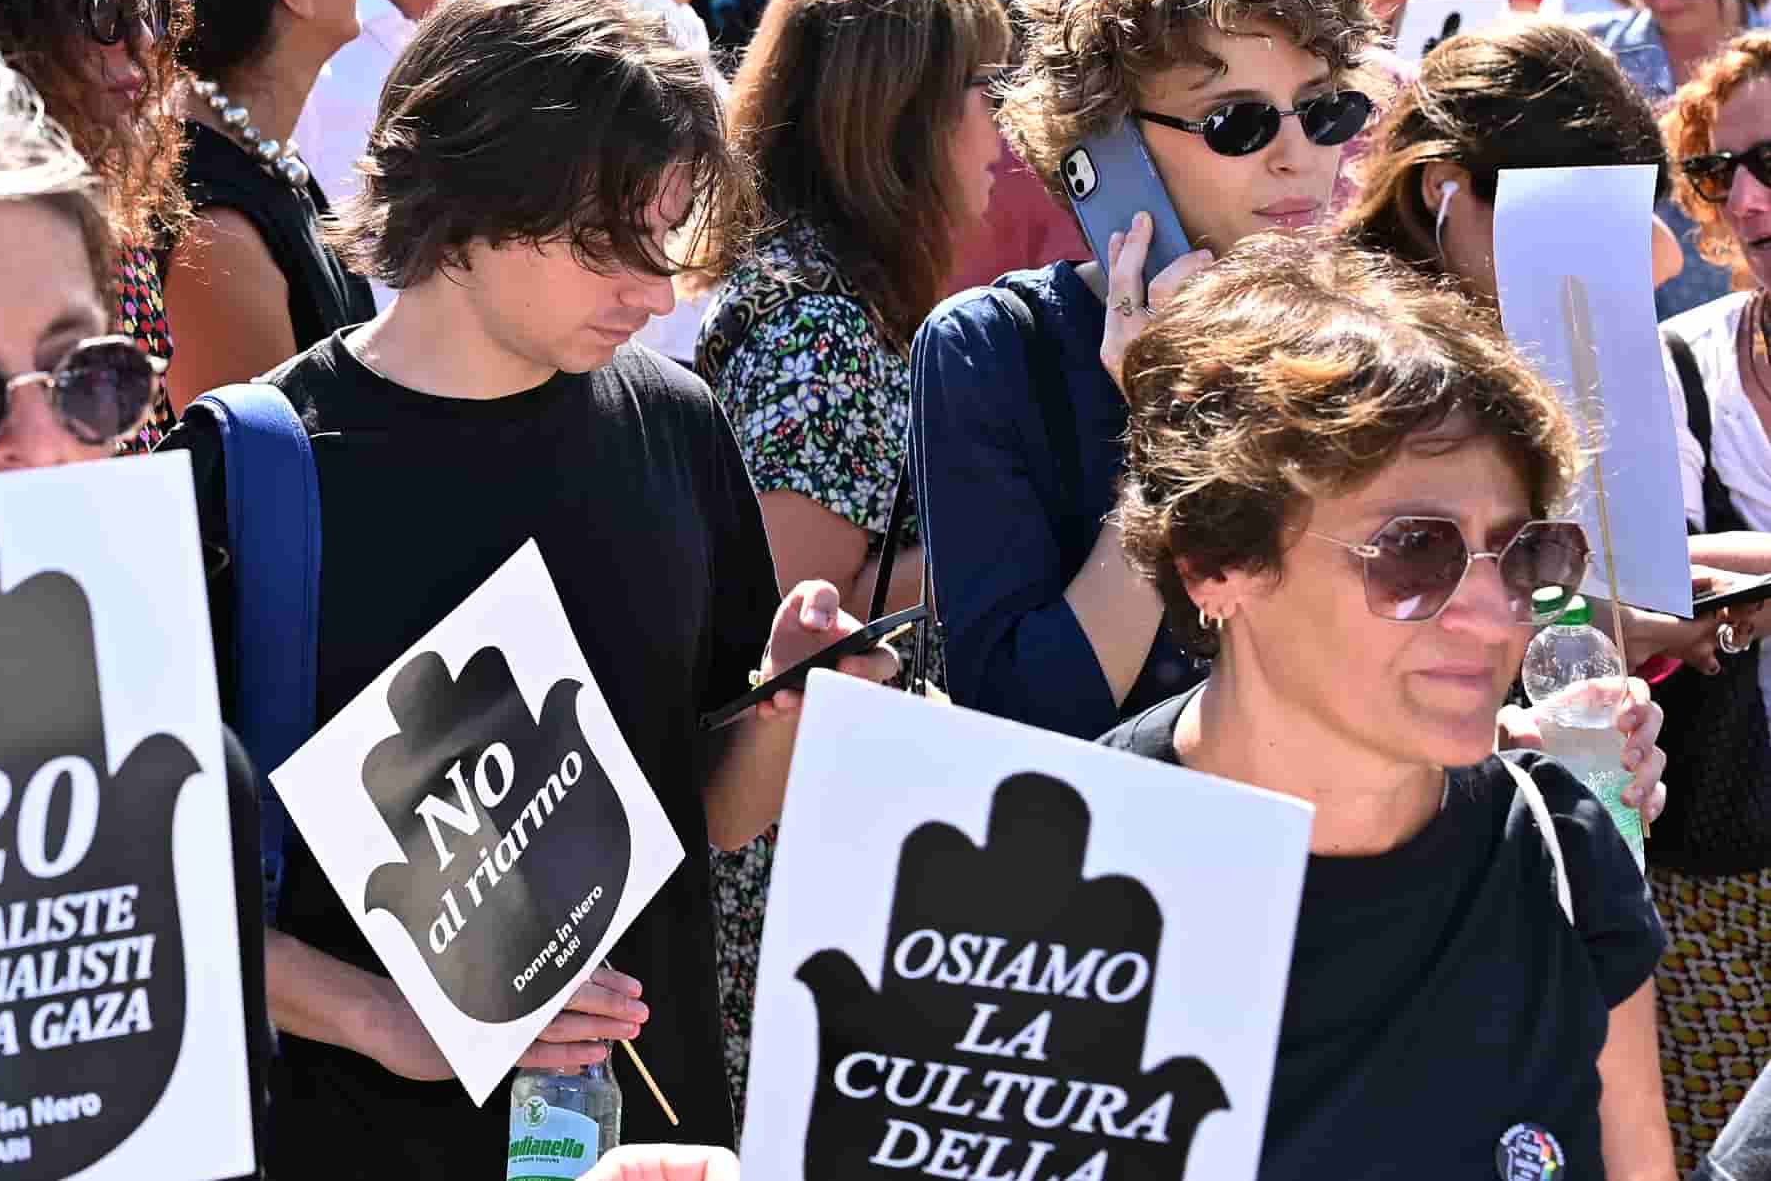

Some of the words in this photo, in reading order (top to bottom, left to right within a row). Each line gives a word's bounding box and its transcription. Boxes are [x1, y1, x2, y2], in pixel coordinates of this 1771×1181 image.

[415, 743, 514, 872] No
[429, 888, 467, 954] al
[464, 751, 582, 907] riarmo
[514, 941, 558, 991] Donne
[556, 923, 572, 942] in
[570, 886, 602, 925] Nero
[554, 936, 581, 968] BARI
[894, 930, 1148, 1002] OSIAMO
[31, 988, 151, 1048] GAZA
[955, 1003, 1052, 1061] LA
[32, 1093, 101, 1125] Nero
[835, 1052, 1172, 1141] CULTURA
[870, 1119, 1108, 1181] DELLA
